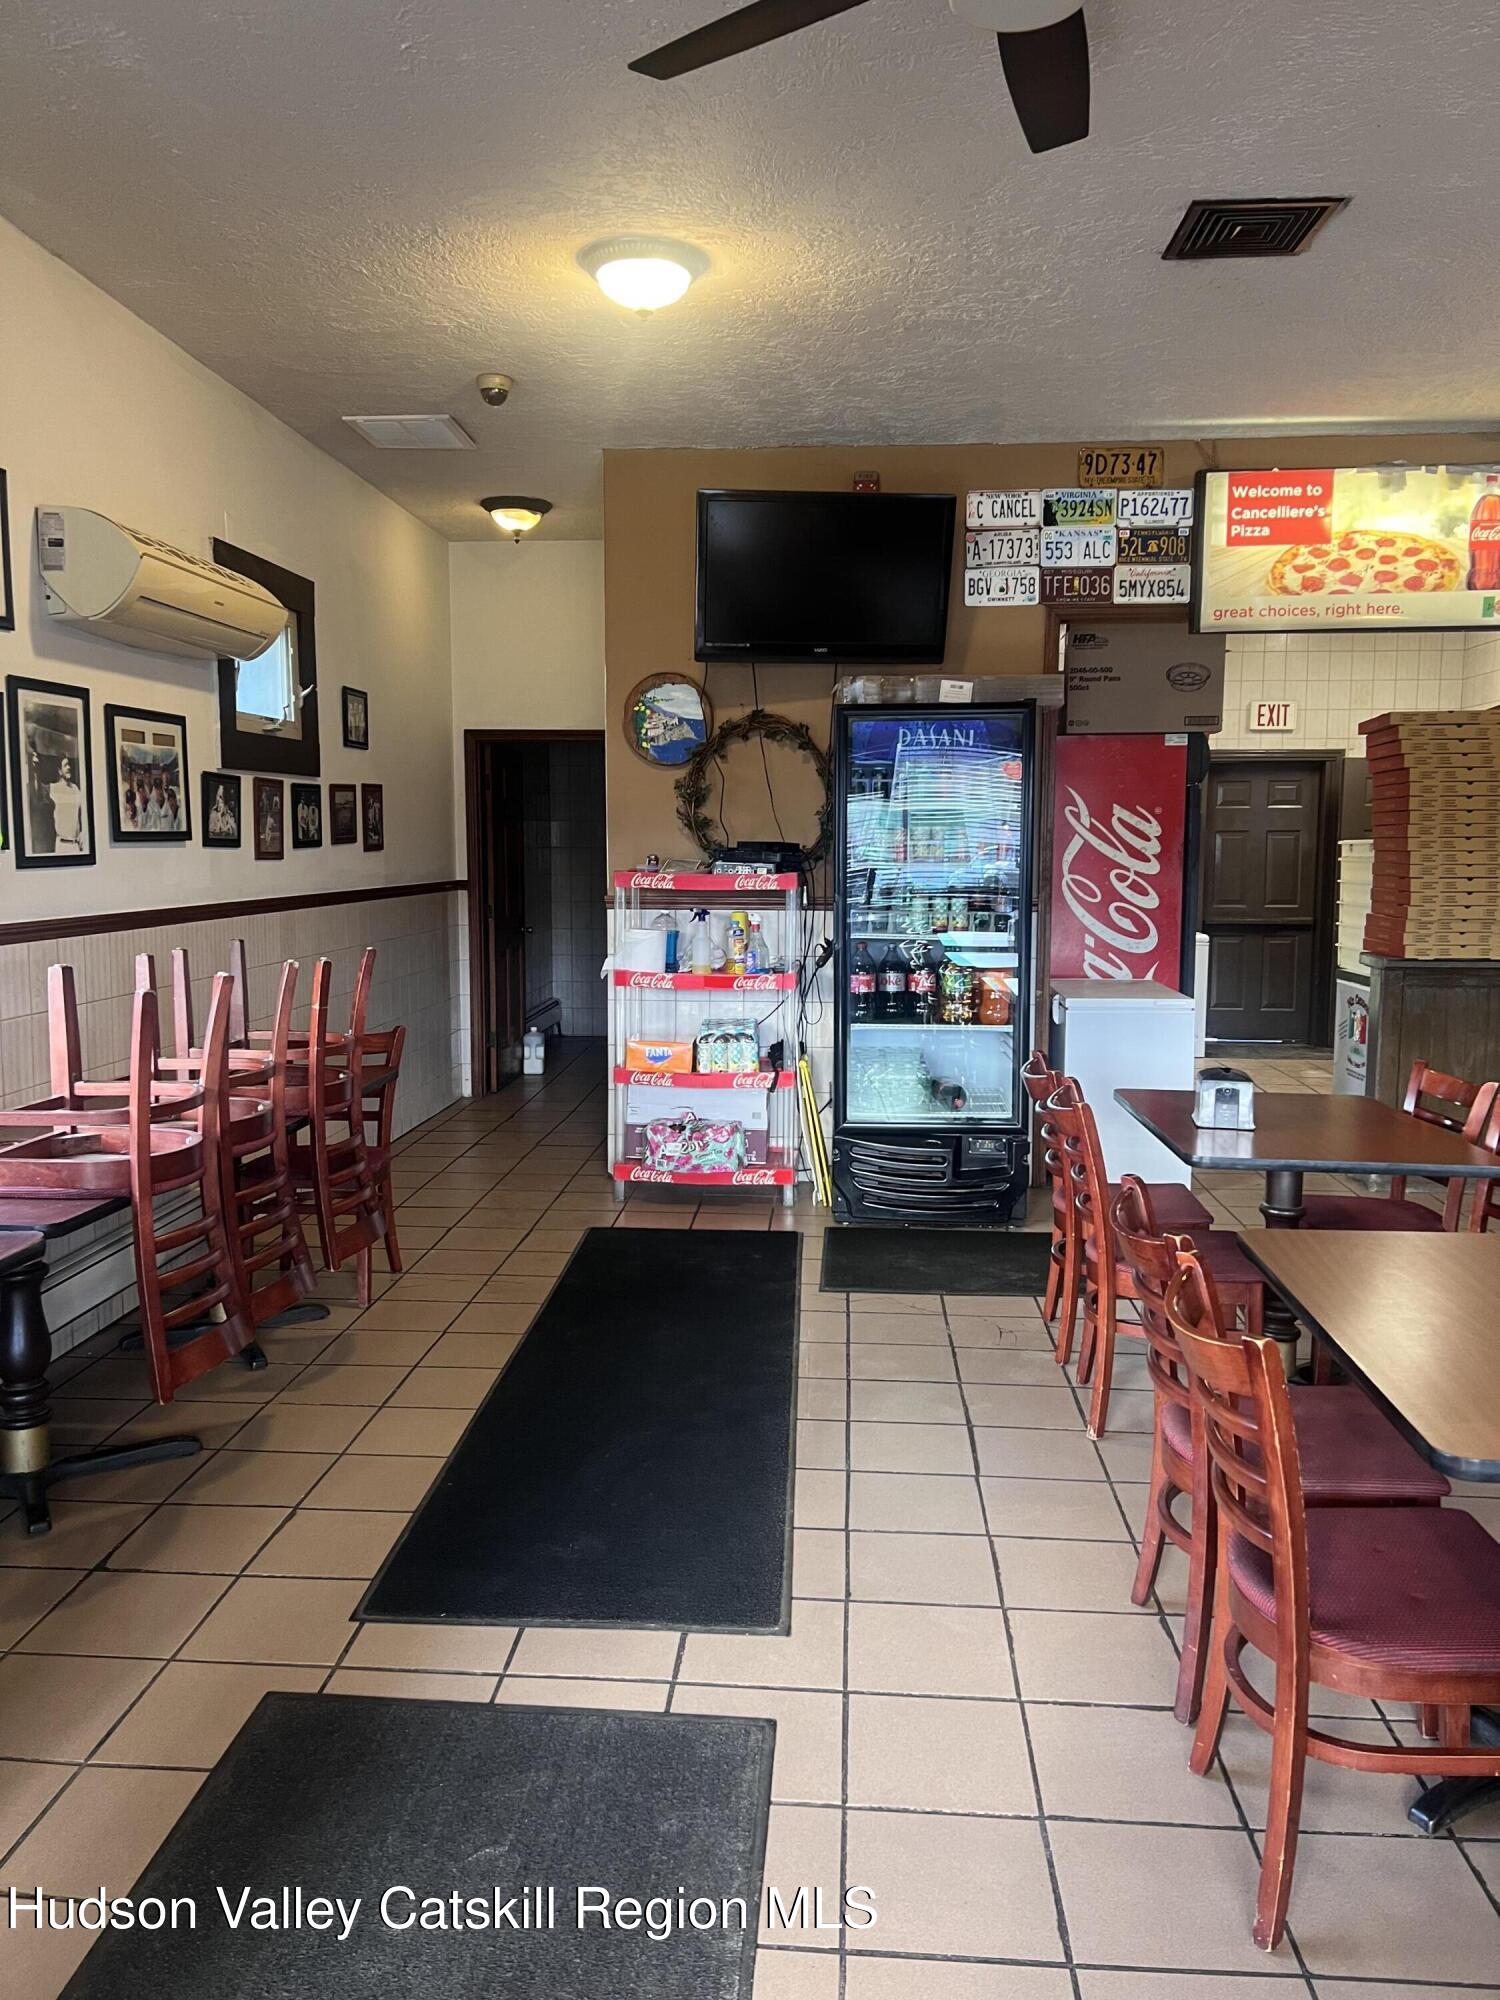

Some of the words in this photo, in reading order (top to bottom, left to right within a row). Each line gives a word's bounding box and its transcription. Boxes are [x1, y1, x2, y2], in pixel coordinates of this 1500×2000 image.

[1232, 485, 1303, 498] Welcome
[1306, 484, 1323, 496] to
[977, 500, 984, 519] C
[991, 499, 1036, 519] CANCEL
[1120, 497, 1189, 516] P162477
[1231, 505, 1326, 520] Cancelliere's
[1059, 529, 1100, 537] KANSAS
[1231, 524, 1270, 537] Pizza
[972, 537, 1033, 560] A-17373
[1045, 541, 1073, 559] 553
[1083, 540, 1111, 559] ALC
[1120, 536, 1146, 556] 52L
[1160, 536, 1185, 556] 908
[982, 569, 1023, 577] GEORGIA
[968, 577, 992, 597] BGV
[1005, 577, 1036, 595] 1758
[1043, 575, 1073, 596] TFE
[1080, 575, 1111, 596] 036
[1119, 579, 1185, 598] 5MYX854
[1213, 607, 1254, 620] great
[1259, 604, 1320, 618] choices,
[1325, 603, 1361, 618] right
[1366, 603, 1405, 615] here.
[1257, 703, 1290, 728] EXIT
[899, 725, 975, 749] DASANI
[631, 873, 675, 890] Coca-Cola
[735, 873, 780, 890] Coca-Cola
[630, 973, 675, 989] Coca-Cola
[733, 974, 778, 990] Coca-Cola
[645, 1047, 672, 1057] FANTA
[630, 1072, 675, 1086] Coca-Cola
[630, 1166, 674, 1183] Coca-Cola
[732, 1169, 776, 1185] Coca-Cola
